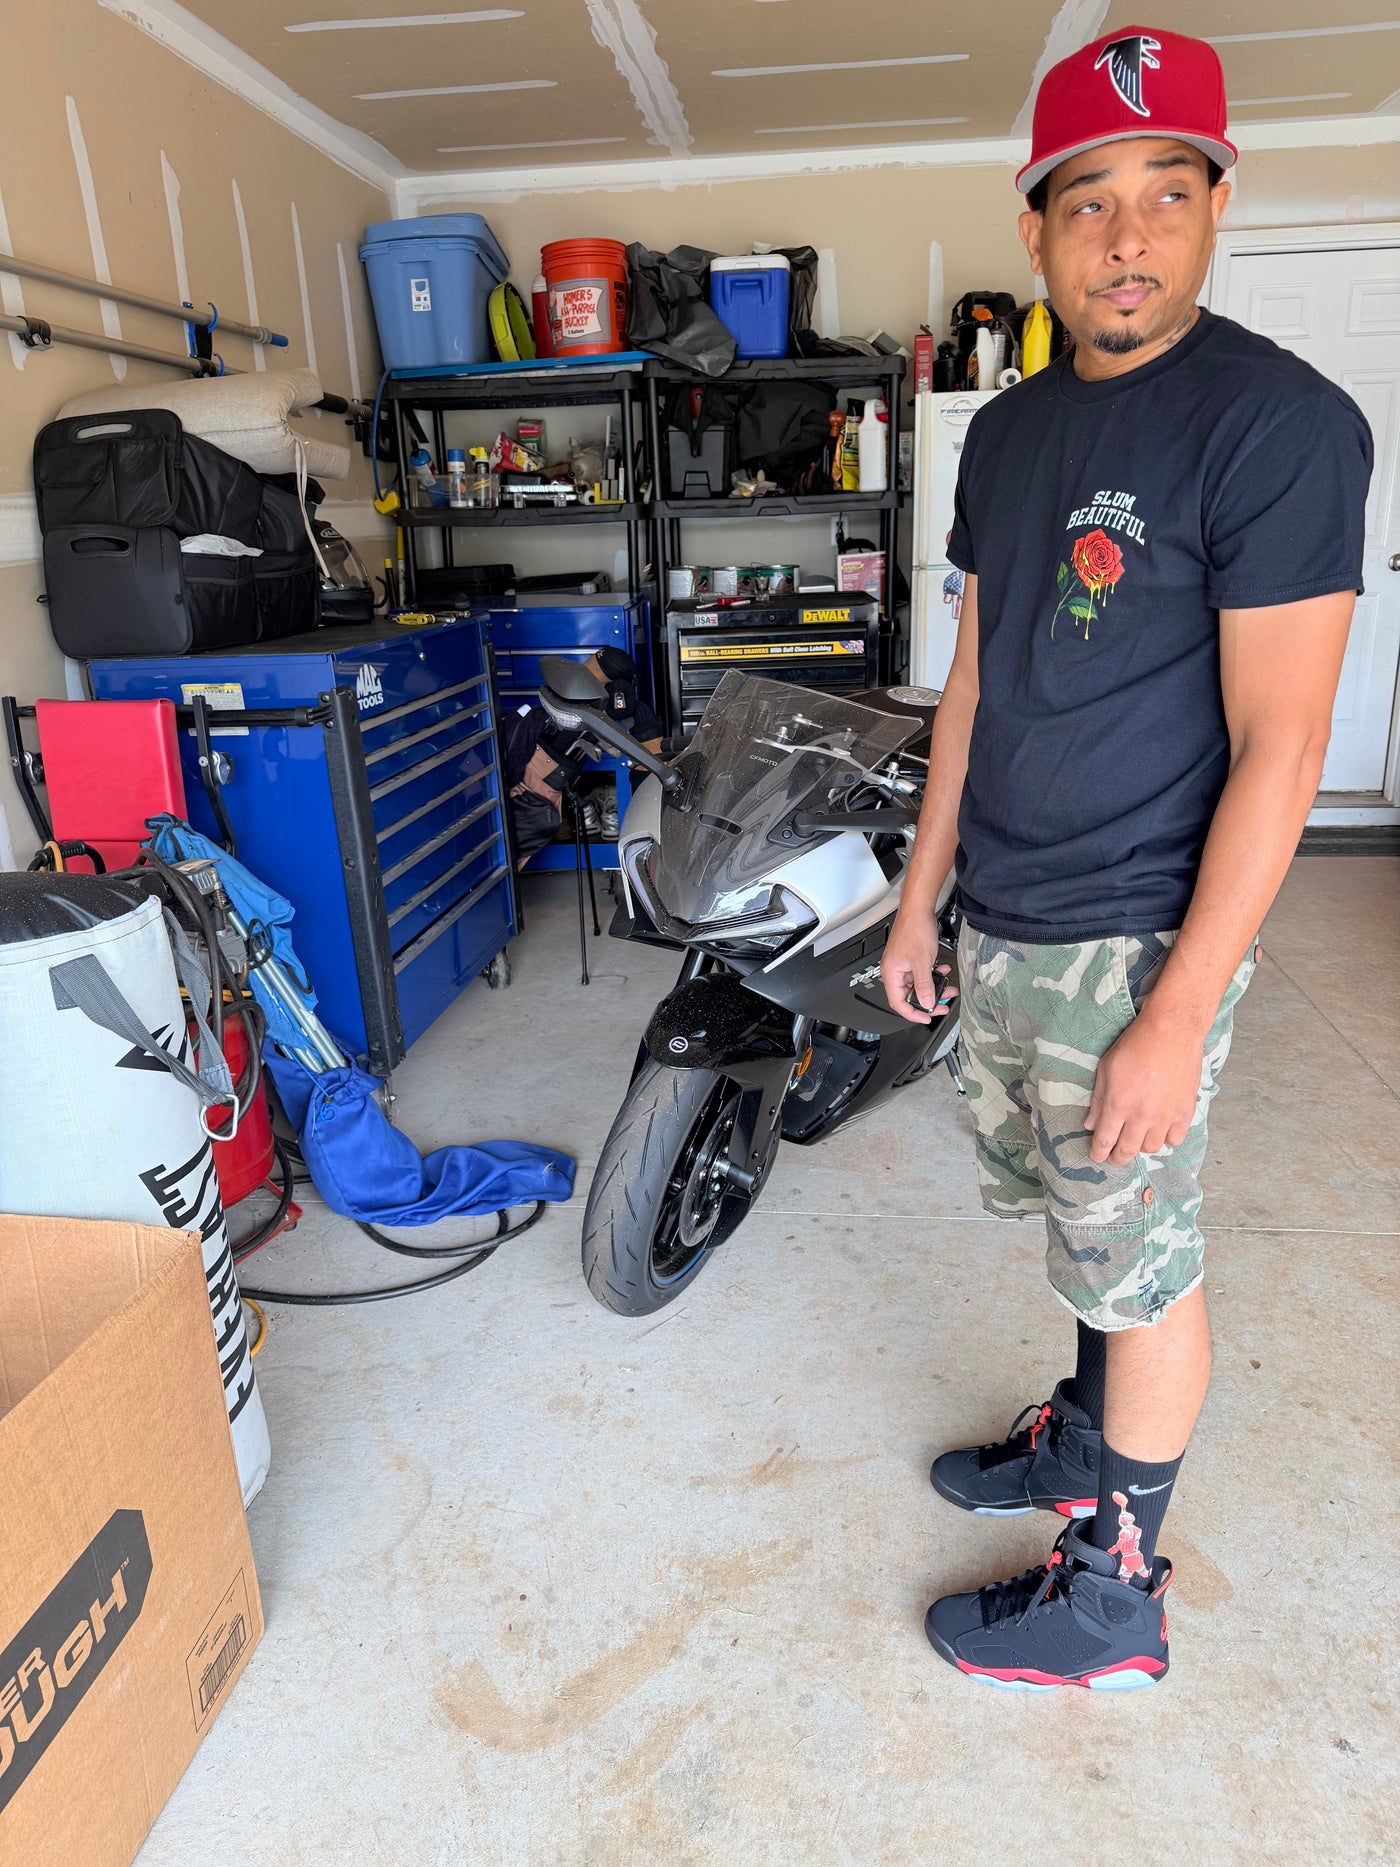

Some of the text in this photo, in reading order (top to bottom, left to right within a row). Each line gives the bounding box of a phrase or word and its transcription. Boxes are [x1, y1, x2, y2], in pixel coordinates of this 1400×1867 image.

[563, 289, 593, 306] HOMER'S
[565, 316, 589, 329] BUCKET
[1091, 490, 1137, 512] SLUM
[1065, 506, 1146, 546] BEAUTIFUL
[695, 615, 711, 625] USA
[356, 663, 382, 699] MAC
[357, 692, 384, 710] TOOLS
[617, 699, 624, 709] 3
[749, 755, 778, 767] CFMOTO
